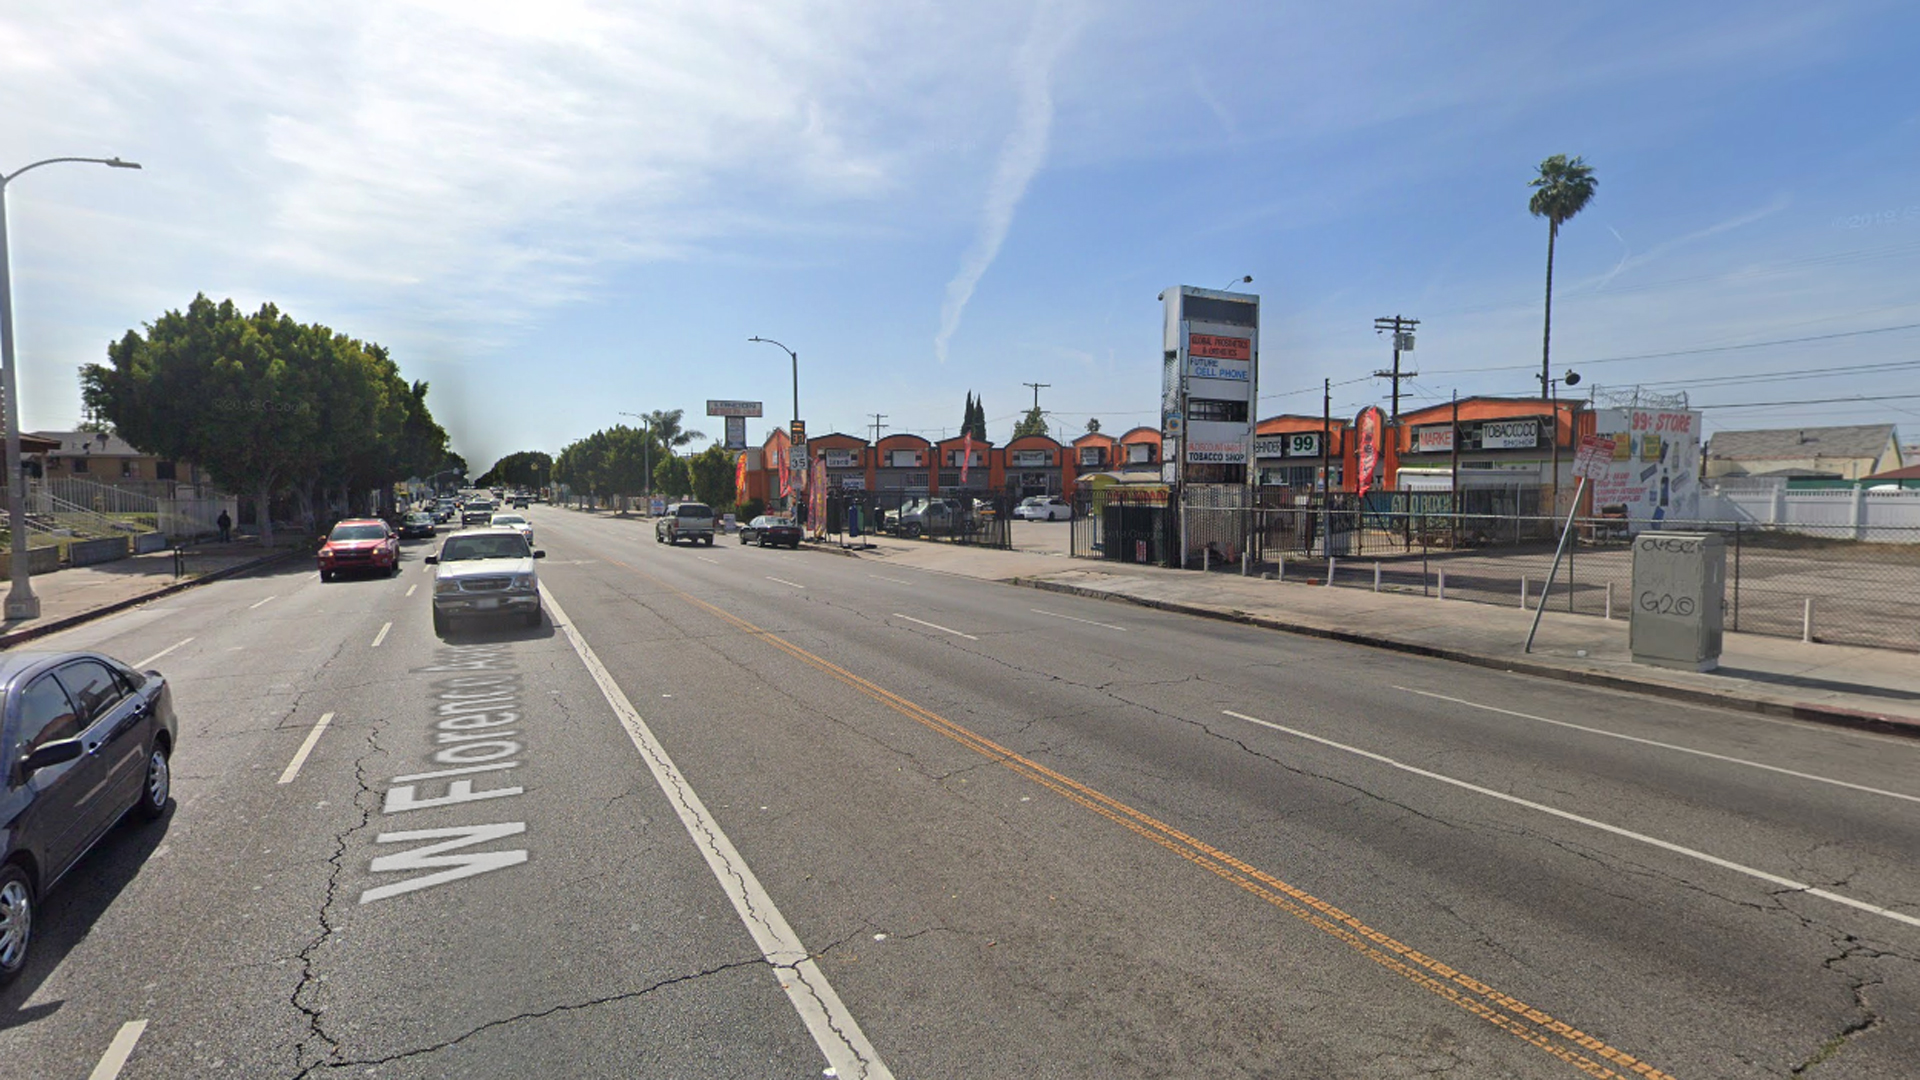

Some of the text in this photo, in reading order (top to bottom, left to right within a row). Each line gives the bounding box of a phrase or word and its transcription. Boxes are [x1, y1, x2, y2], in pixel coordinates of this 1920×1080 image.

[1190, 357, 1218, 367] FUTURE
[1195, 366, 1248, 379] CELL PHONE
[1655, 412, 1692, 433] STORE
[1189, 452, 1245, 461] TOBACCO SHOP
[792, 458, 806, 468] 35
